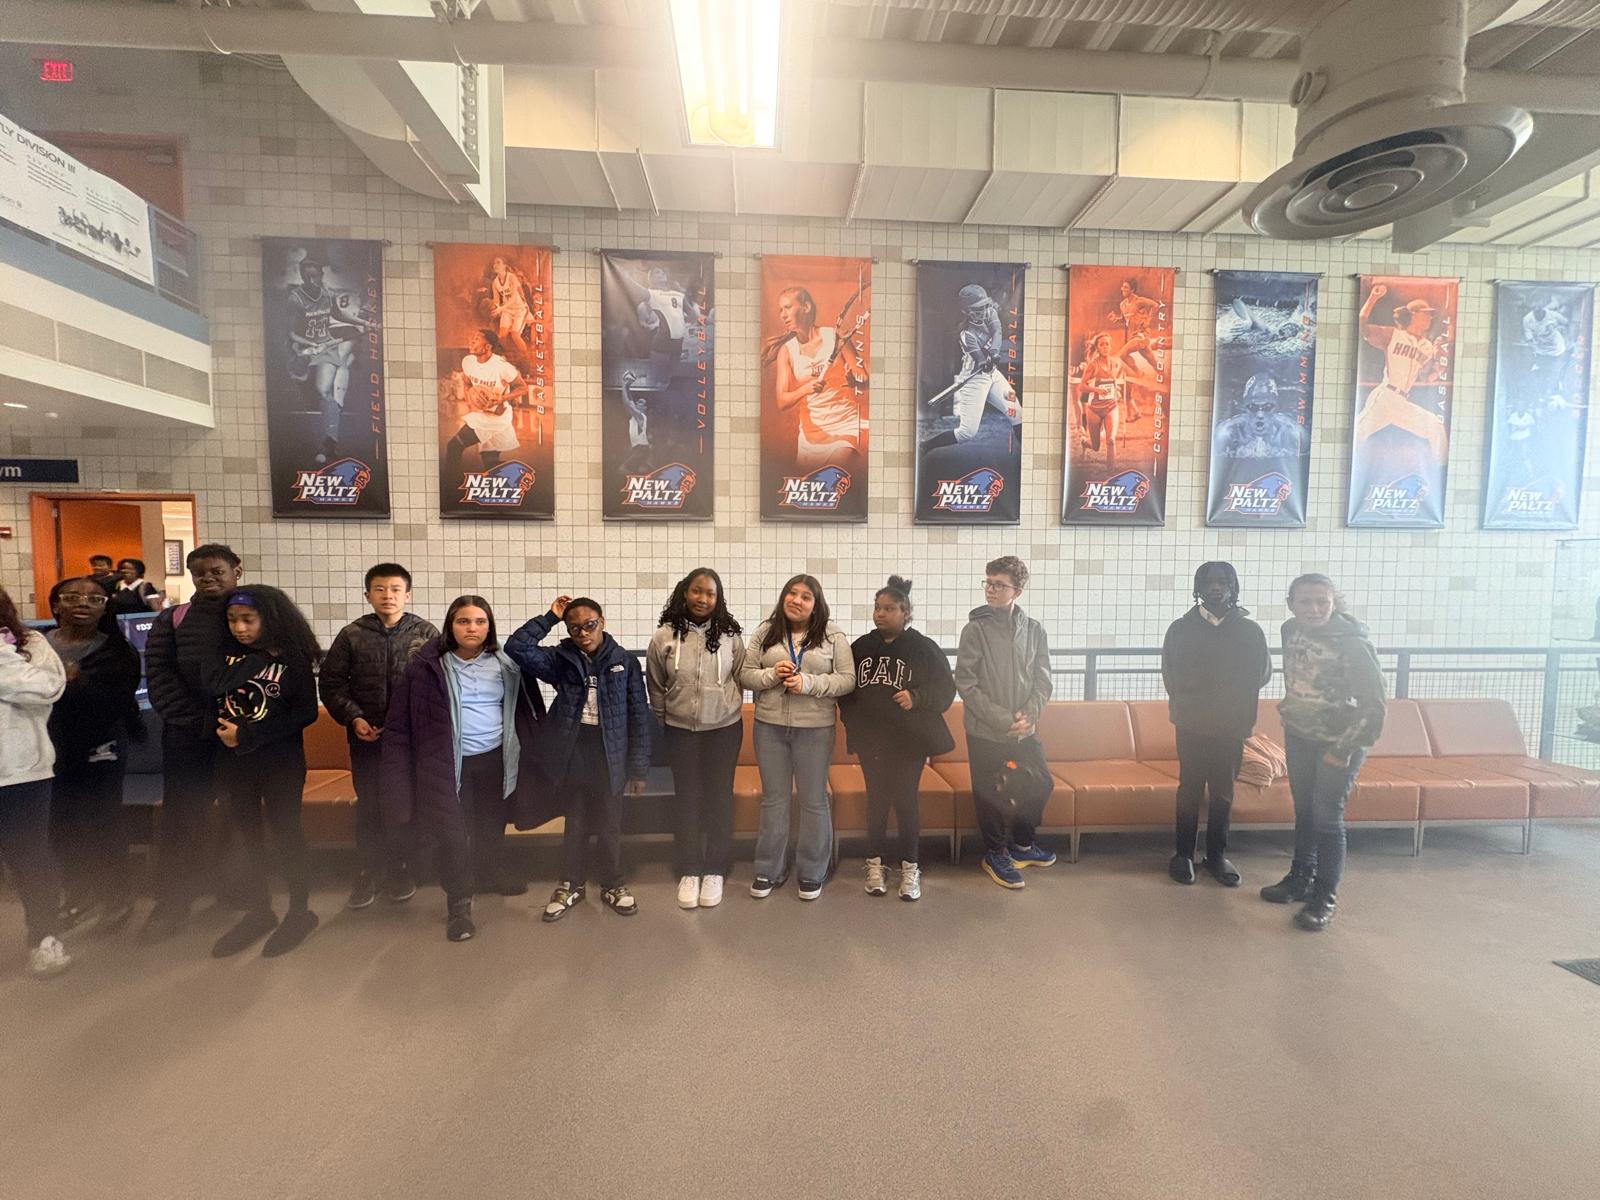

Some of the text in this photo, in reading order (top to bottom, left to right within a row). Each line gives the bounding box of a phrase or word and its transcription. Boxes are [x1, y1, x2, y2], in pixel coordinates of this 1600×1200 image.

[0, 121, 14, 136] LY
[17, 133, 65, 168] DIVISION
[68, 163, 76, 174] III
[367, 274, 382, 433] FIELD HOCKEY
[535, 284, 545, 415] BASKETBALL
[854, 314, 866, 396] TENNIS
[697, 286, 706, 429] VOLLEYBALL
[1007, 306, 1018, 418] SOFTBALL
[1437, 315, 1451, 424] BASEBALL
[1153, 300, 1167, 453] CROSS COUNTRY
[299, 473, 343, 487] NEW
[465, 475, 508, 488] NEW
[627, 477, 669, 490] NEW
[784, 478, 825, 491] NEW
[302, 486, 358, 498] PALTZ
[467, 487, 522, 499] PALTZ
[938, 482, 979, 494] NEW
[1086, 483, 1126, 496] NEW
[1229, 485, 1267, 498] NEW
[1370, 487, 1406, 499] NEW
[629, 490, 683, 501] PALTZ
[786, 491, 839, 503] PALTZ
[940, 494, 992, 506] PALTZ
[1088, 495, 1138, 506] PALTZ
[1506, 489, 1543, 501] NEW
[1231, 497, 1280, 508] PALTZ
[1372, 498, 1419, 509] PALTZ
[1508, 500, 1553, 511] PALTZ
